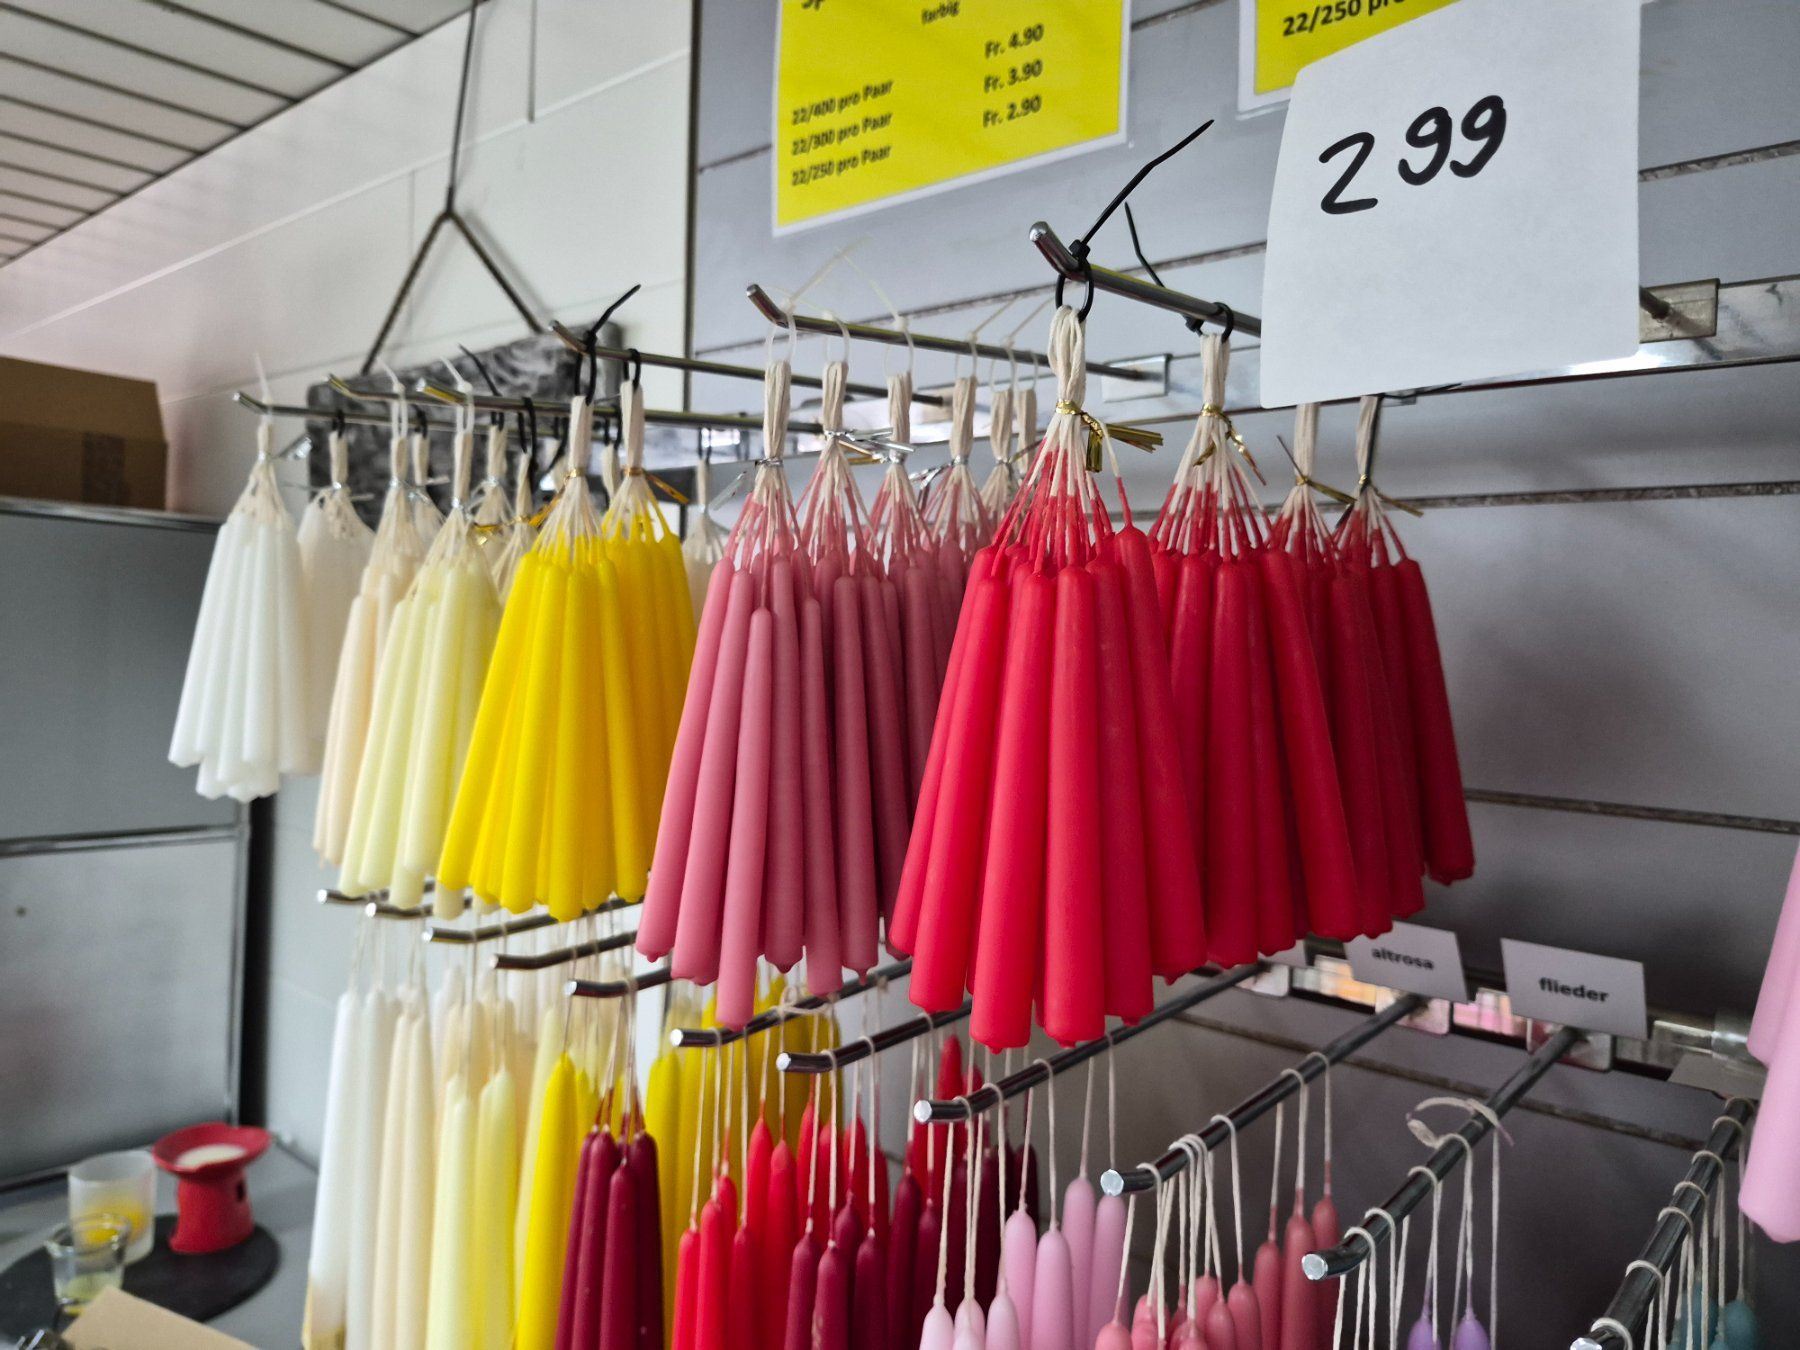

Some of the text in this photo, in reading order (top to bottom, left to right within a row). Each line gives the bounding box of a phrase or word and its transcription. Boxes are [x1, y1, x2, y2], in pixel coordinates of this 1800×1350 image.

[1282, 0, 1405, 36] 22/250 pr
[985, 24, 1044, 58] Fr. 4.90
[984, 59, 1043, 93] Fr. 3.90
[838, 93, 860, 113] pro
[862, 81, 892, 101] Paar
[983, 95, 1042, 128] Fr. 2.90
[792, 113, 892, 156] 22/300 pro Paar
[792, 146, 891, 186] 22/250 pro Paar
[1319, 95, 1507, 214] 2 99
[1371, 947, 1434, 971] altrosa
[1538, 976, 1609, 1002] flieder
